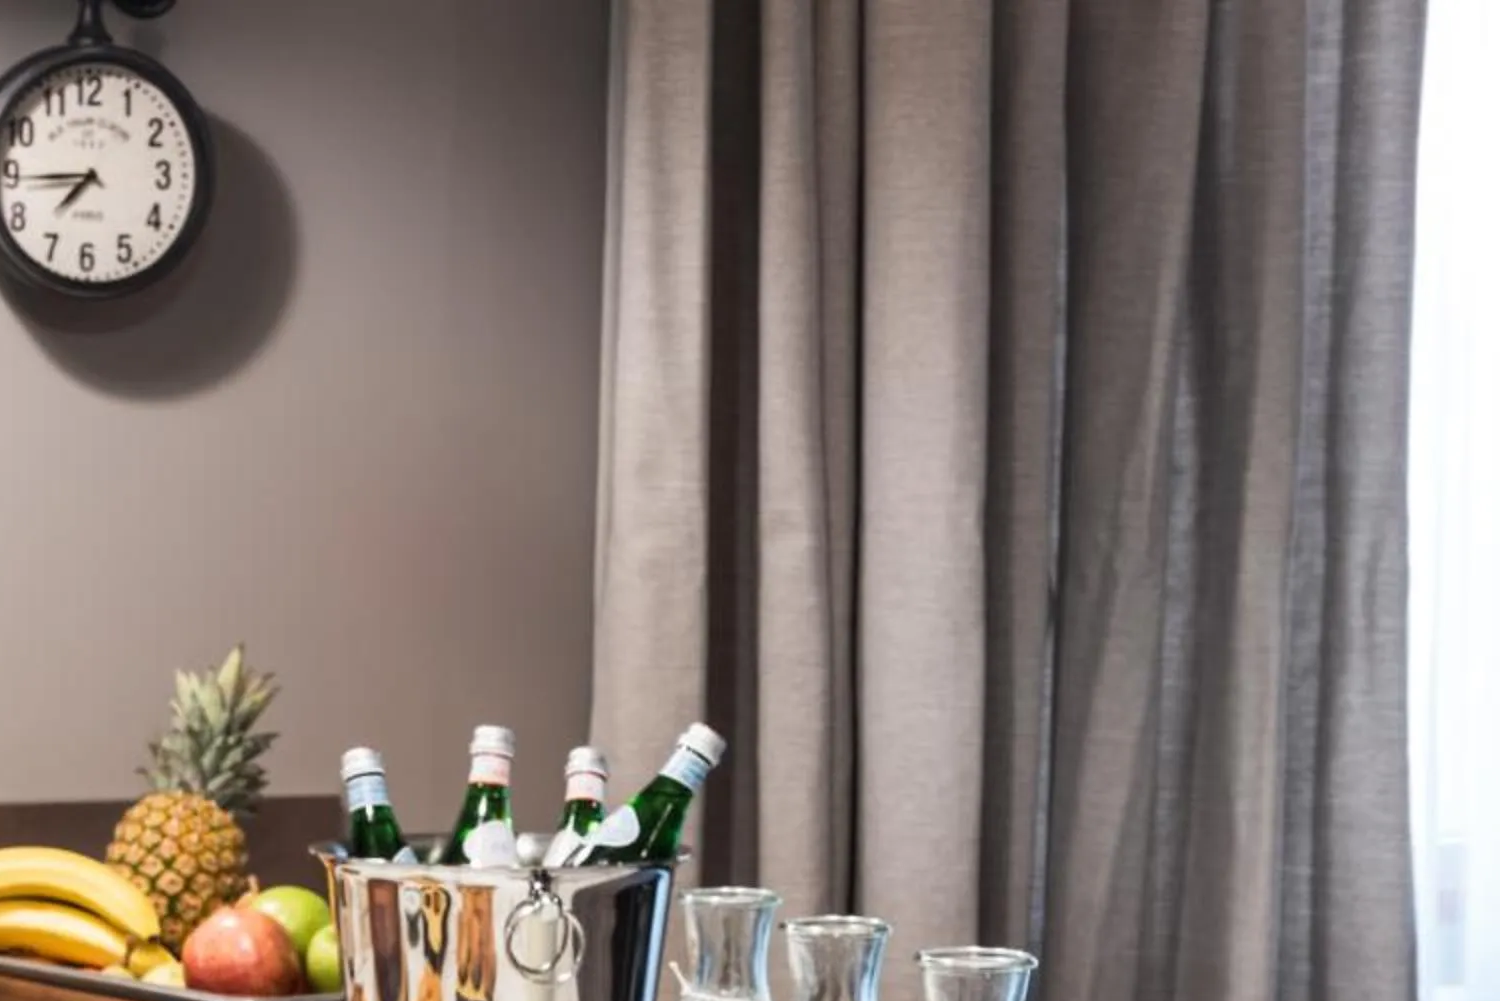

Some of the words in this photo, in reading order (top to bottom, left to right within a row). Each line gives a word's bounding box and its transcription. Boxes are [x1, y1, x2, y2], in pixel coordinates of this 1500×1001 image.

[43, 88, 66, 117] 11
[76, 76, 103, 107] 12
[123, 89, 133, 117] 1
[8, 117, 34, 148] 10
[148, 118, 164, 148] 2
[3, 159, 20, 189] 9
[156, 161, 172, 190] 3
[10, 202, 27, 232] 8
[145, 203, 162, 231] 4
[42, 233, 60, 262] 7
[78, 243, 95, 273] 6
[116, 235, 133, 264] 5
